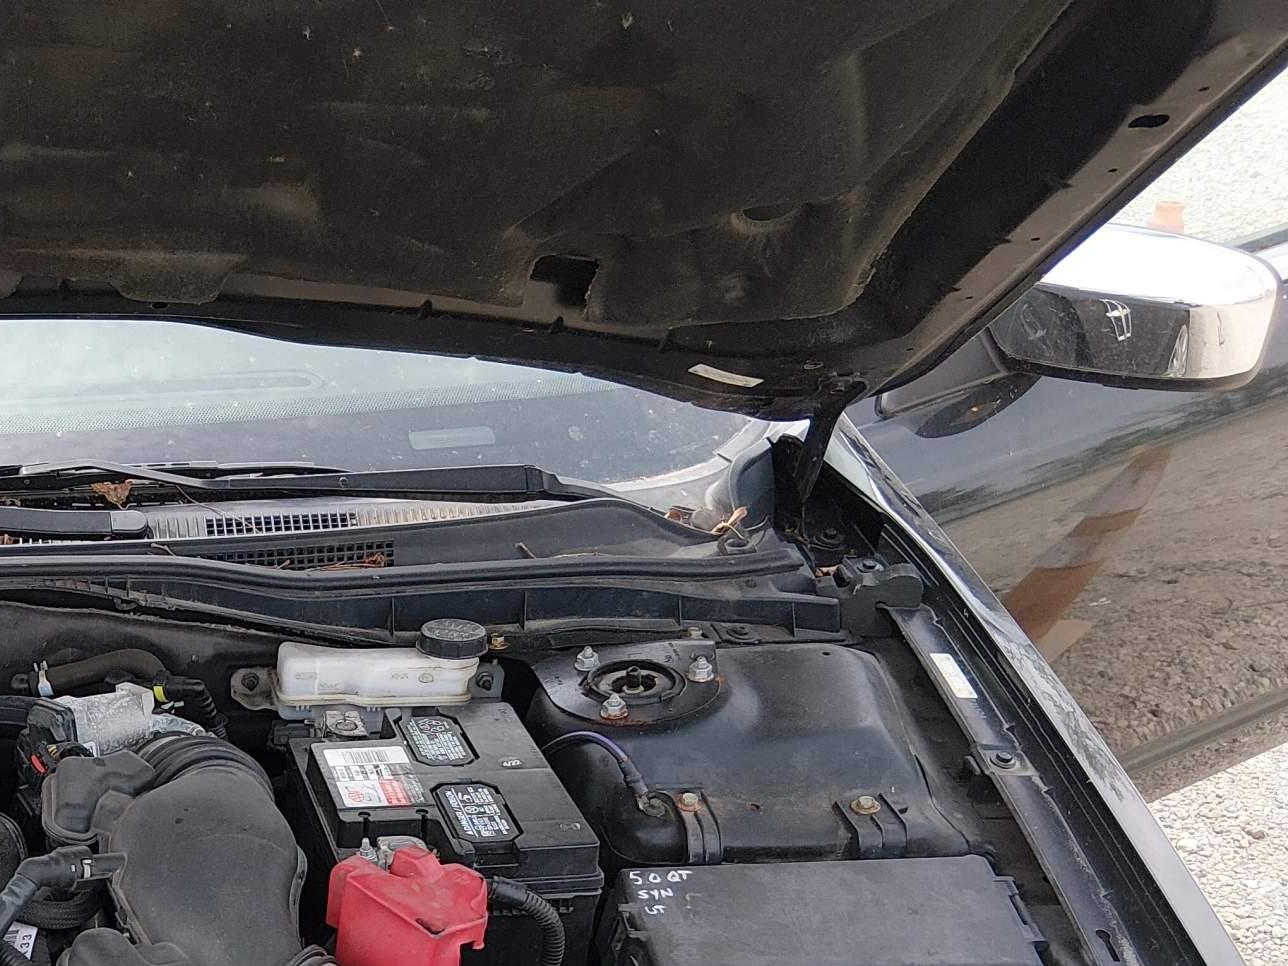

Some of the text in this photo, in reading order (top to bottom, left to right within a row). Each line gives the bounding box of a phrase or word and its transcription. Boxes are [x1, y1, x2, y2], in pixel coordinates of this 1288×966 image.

[629, 869, 693, 885] 5.0 QT
[637, 887, 674, 901] SYN
